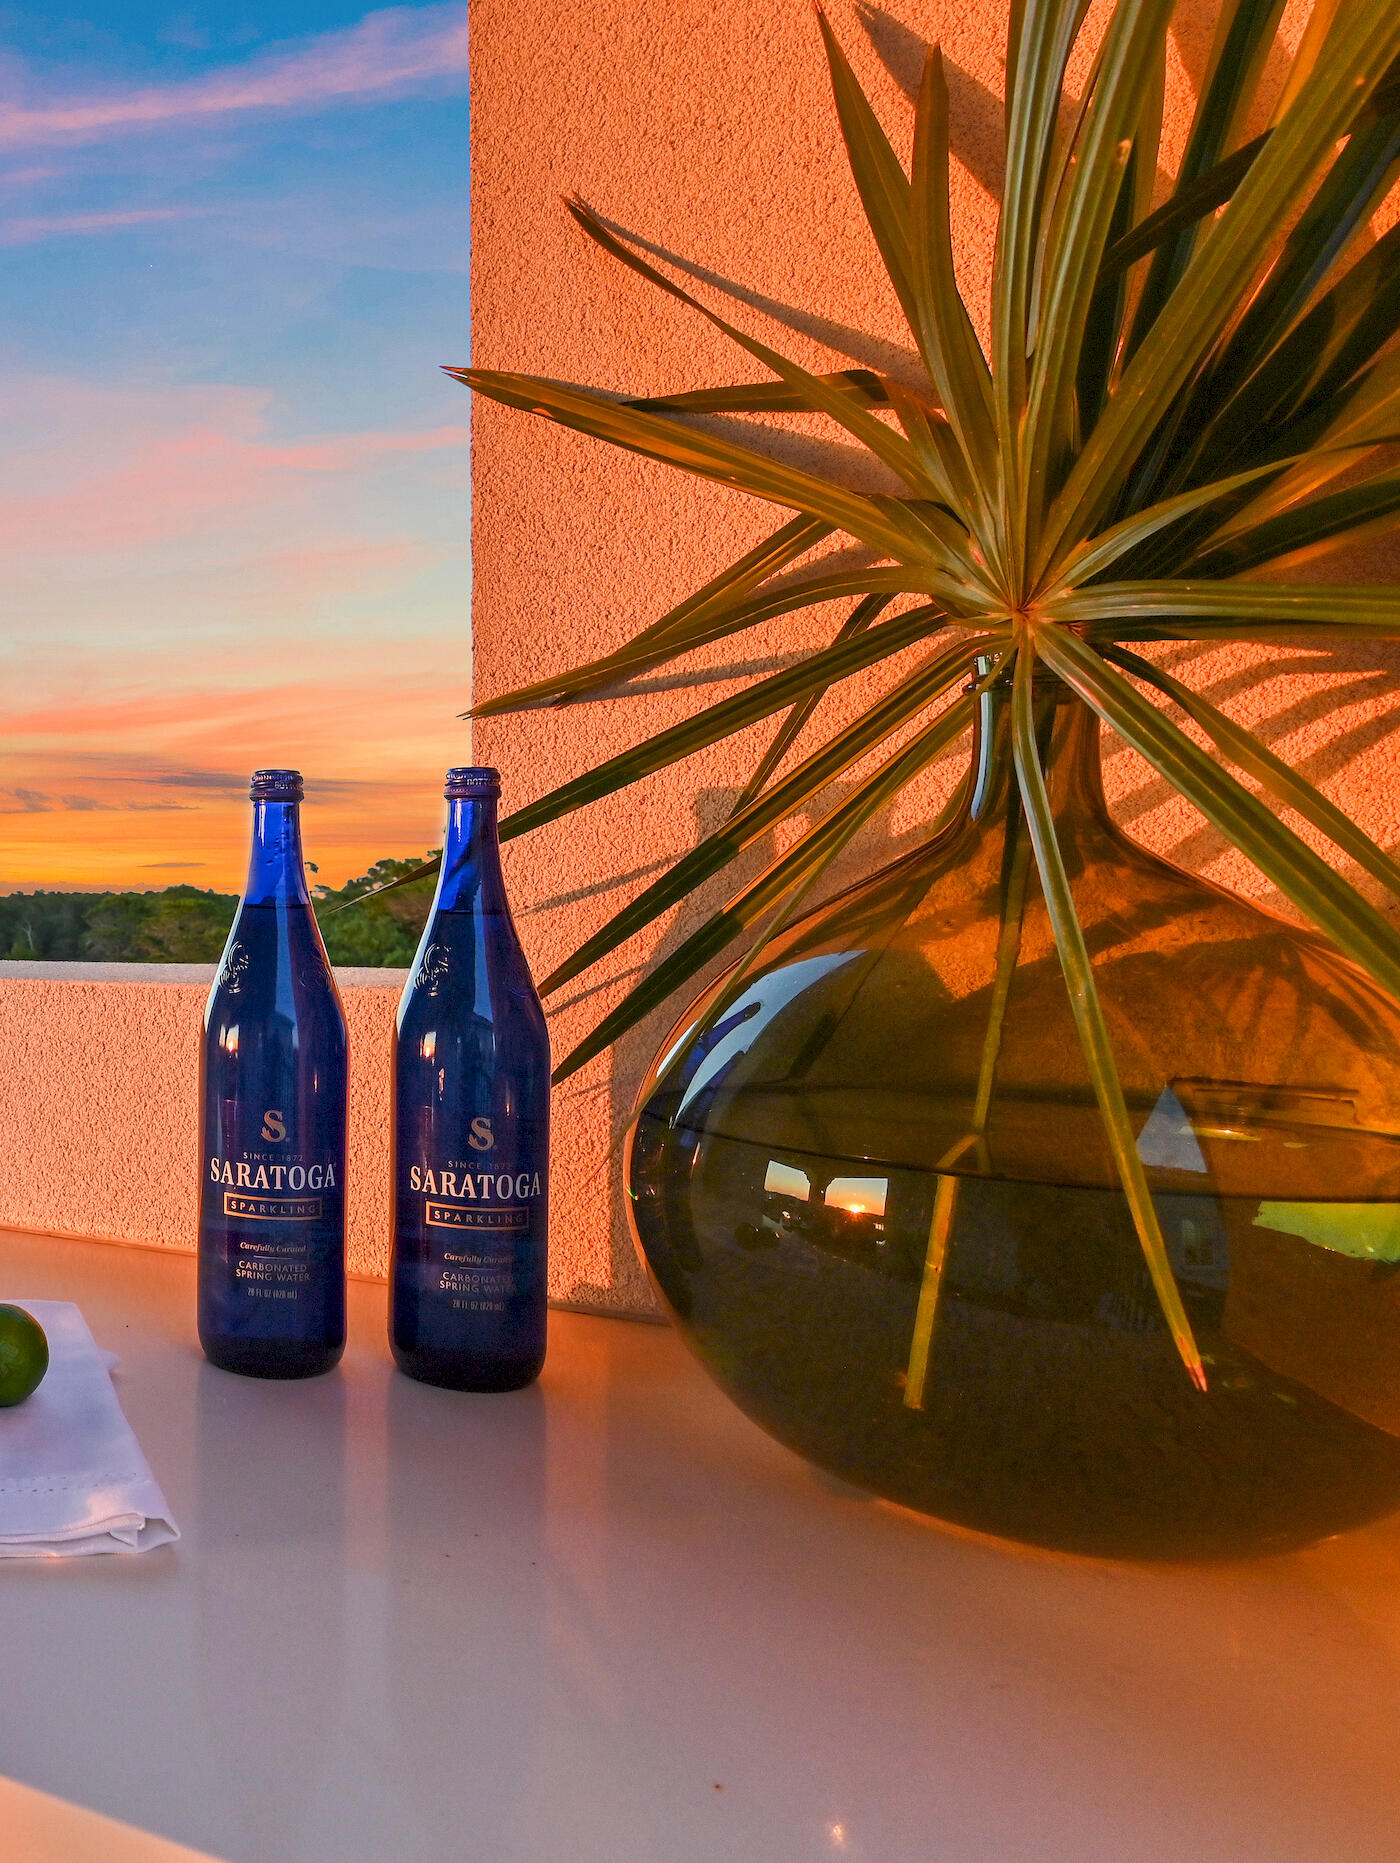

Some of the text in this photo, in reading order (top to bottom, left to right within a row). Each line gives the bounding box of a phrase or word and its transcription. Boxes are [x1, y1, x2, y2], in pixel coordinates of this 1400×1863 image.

[261, 1110, 287, 1143] S
[468, 1117, 495, 1151] S
[243, 1151, 274, 1161] SINCE
[448, 1160, 481, 1170] SINCE
[210, 1157, 336, 1191] SARATOGA
[410, 1166, 541, 1199] SARATOGA
[231, 1200, 316, 1214] SPARKLING
[434, 1210, 524, 1223] SPARKLING
[240, 1241, 276, 1253] Carefully
[444, 1252, 482, 1264] Carefully
[239, 1260, 307, 1273] CARBONATED
[236, 1269, 311, 1282] SPRING WATER
[442, 1271, 514, 1284] CARBONATED
[439, 1280, 479, 1293] SPRING
